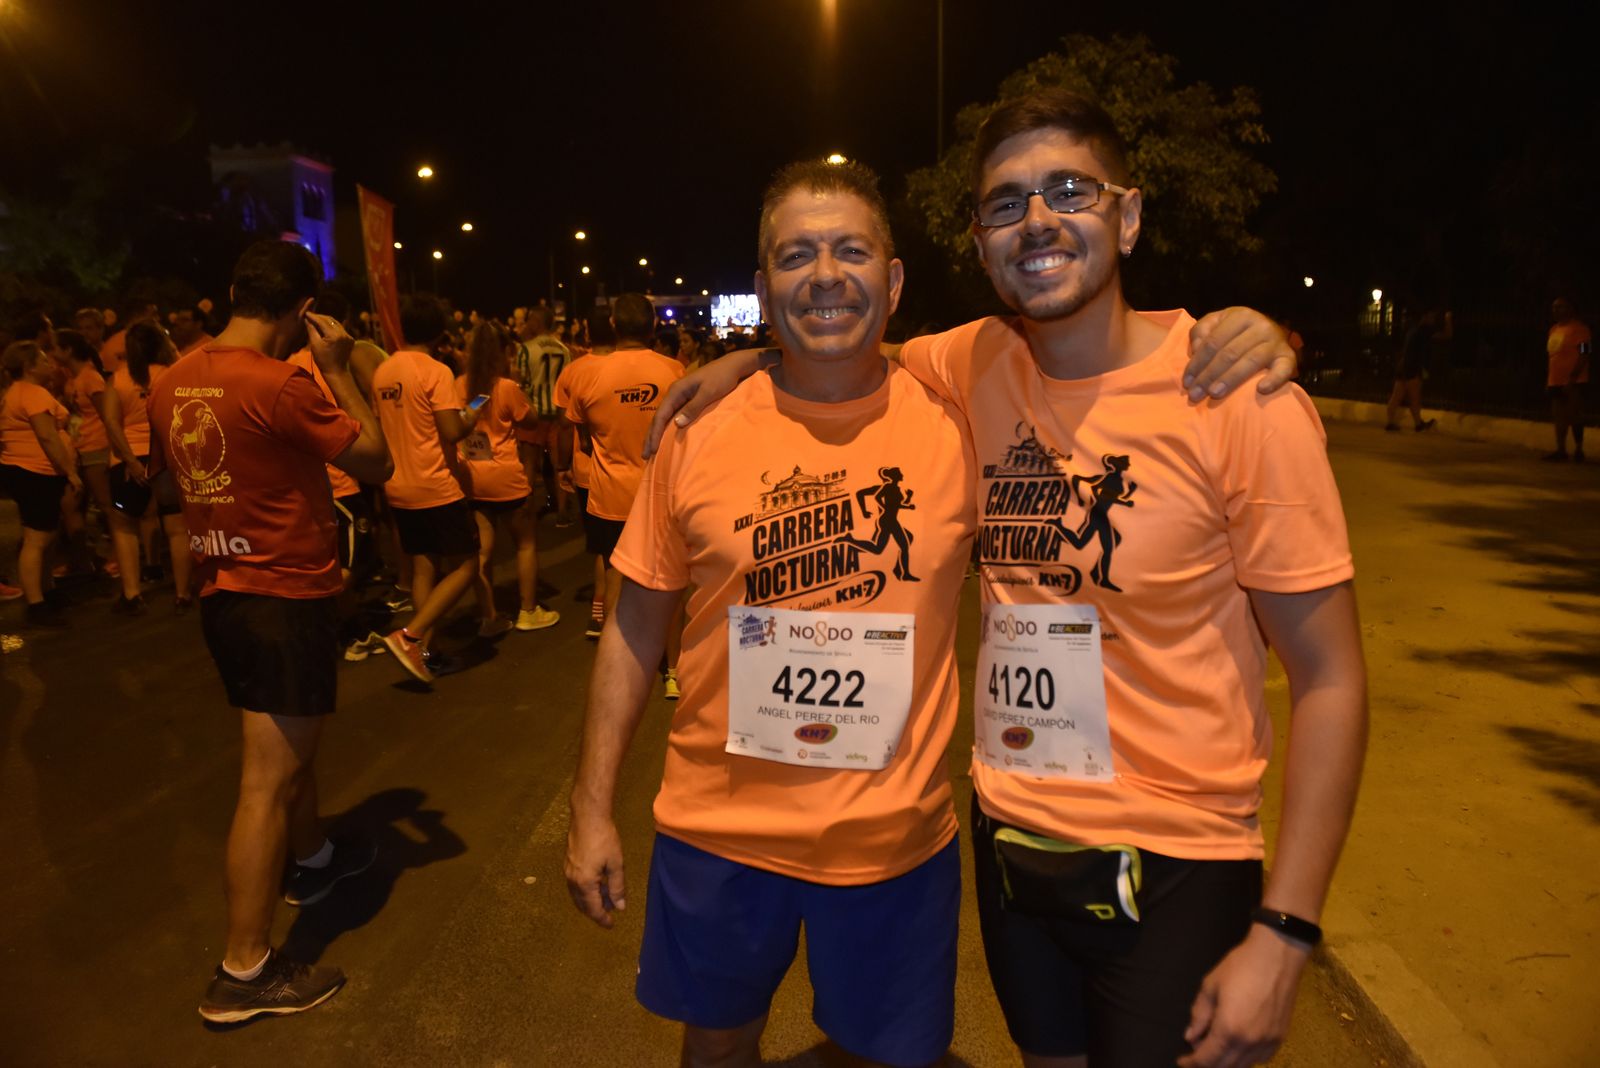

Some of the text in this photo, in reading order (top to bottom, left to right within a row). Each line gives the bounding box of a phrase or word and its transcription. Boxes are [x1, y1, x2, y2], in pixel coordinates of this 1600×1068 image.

[542, 352, 565, 384] 17
[985, 480, 1071, 516] CARRERA
[734, 513, 754, 534] XXXI
[752, 499, 854, 560] CARRERA
[188, 530, 251, 556] evilla
[970, 526, 1062, 563] NOCTURNA
[744, 544, 861, 604] NOCTURNA
[772, 665, 866, 708] 4222
[989, 663, 1056, 711] 4120
[757, 706, 880, 725] ANGEL PEREZ DEL RIO
[1027, 716, 1075, 730] CAMPÓN
